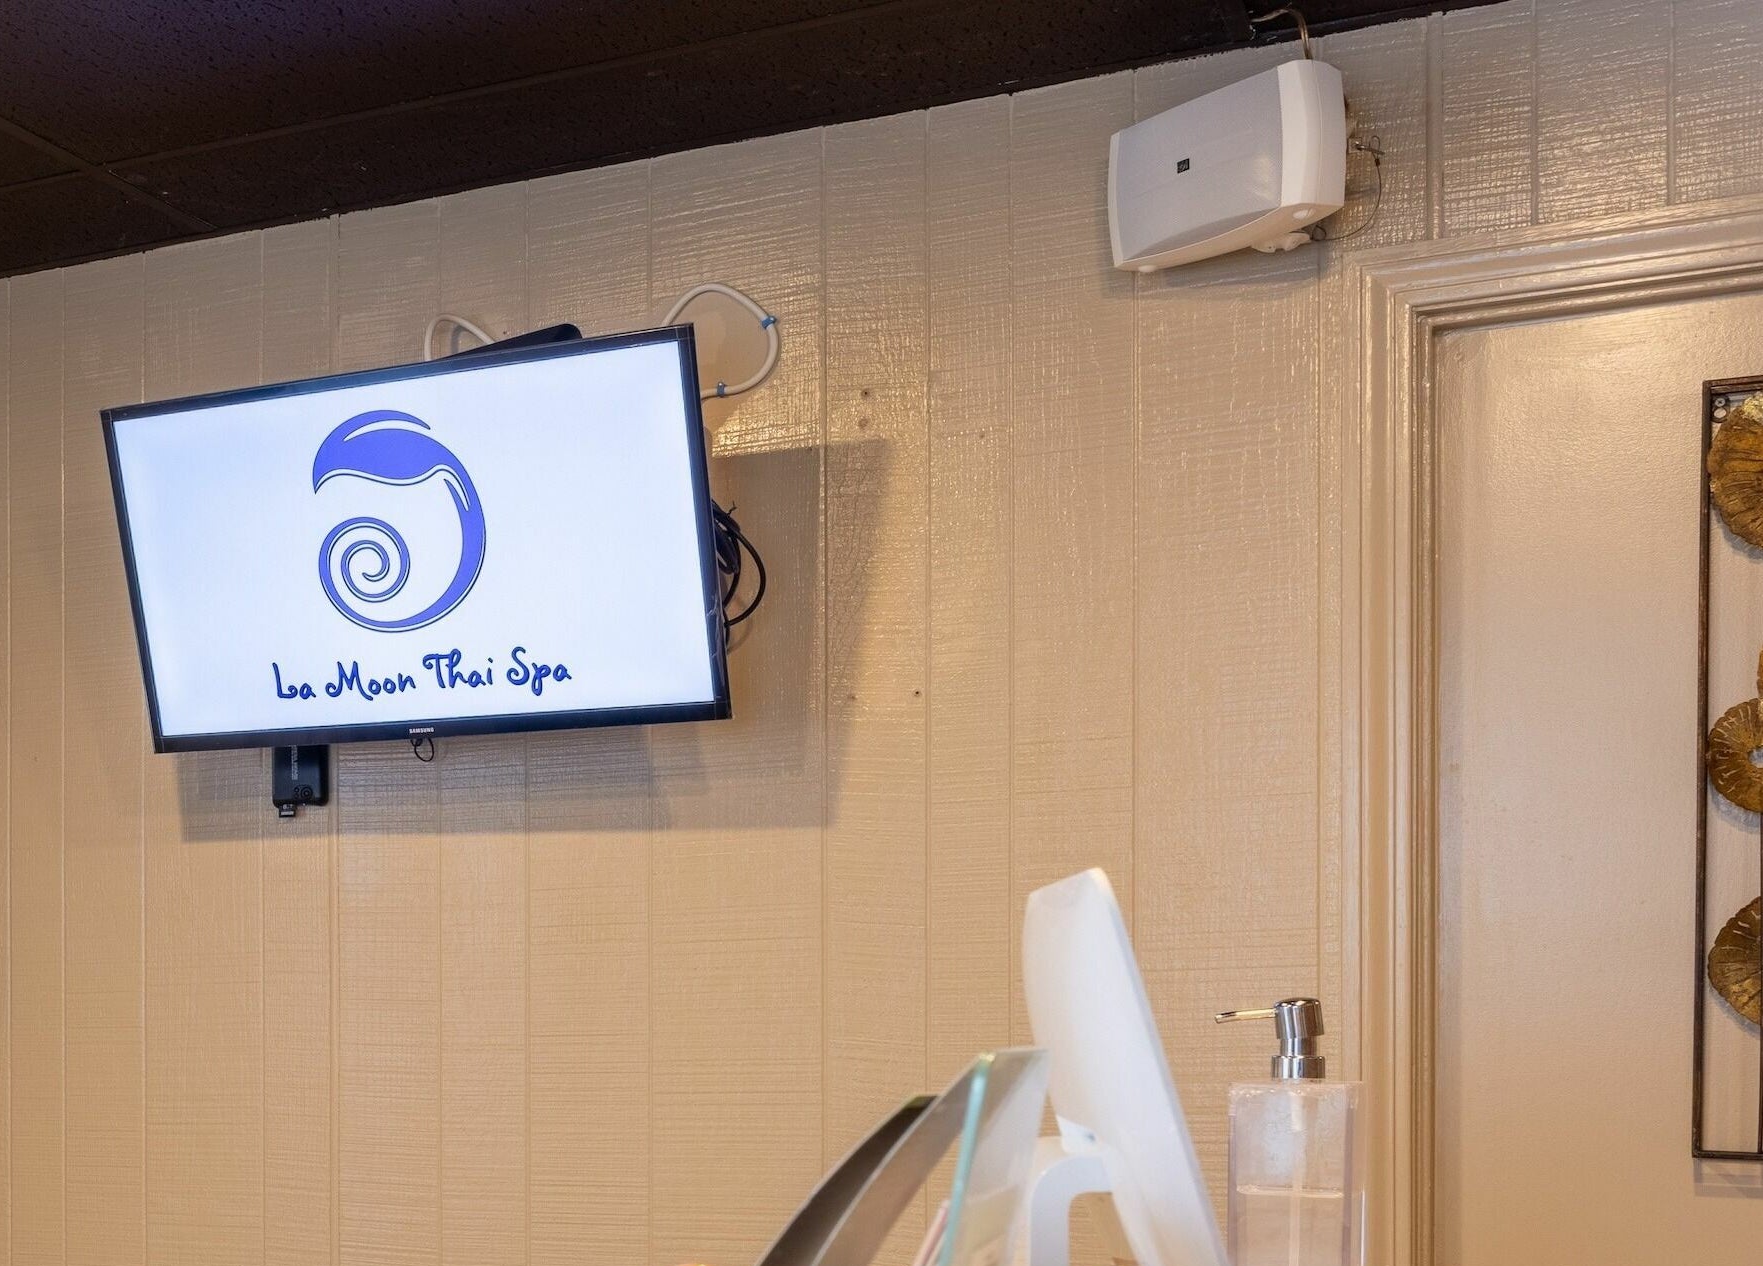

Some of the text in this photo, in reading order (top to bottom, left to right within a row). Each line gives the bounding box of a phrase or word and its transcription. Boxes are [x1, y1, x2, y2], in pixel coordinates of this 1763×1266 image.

[271, 646, 573, 701] La Moon Thai Spa
